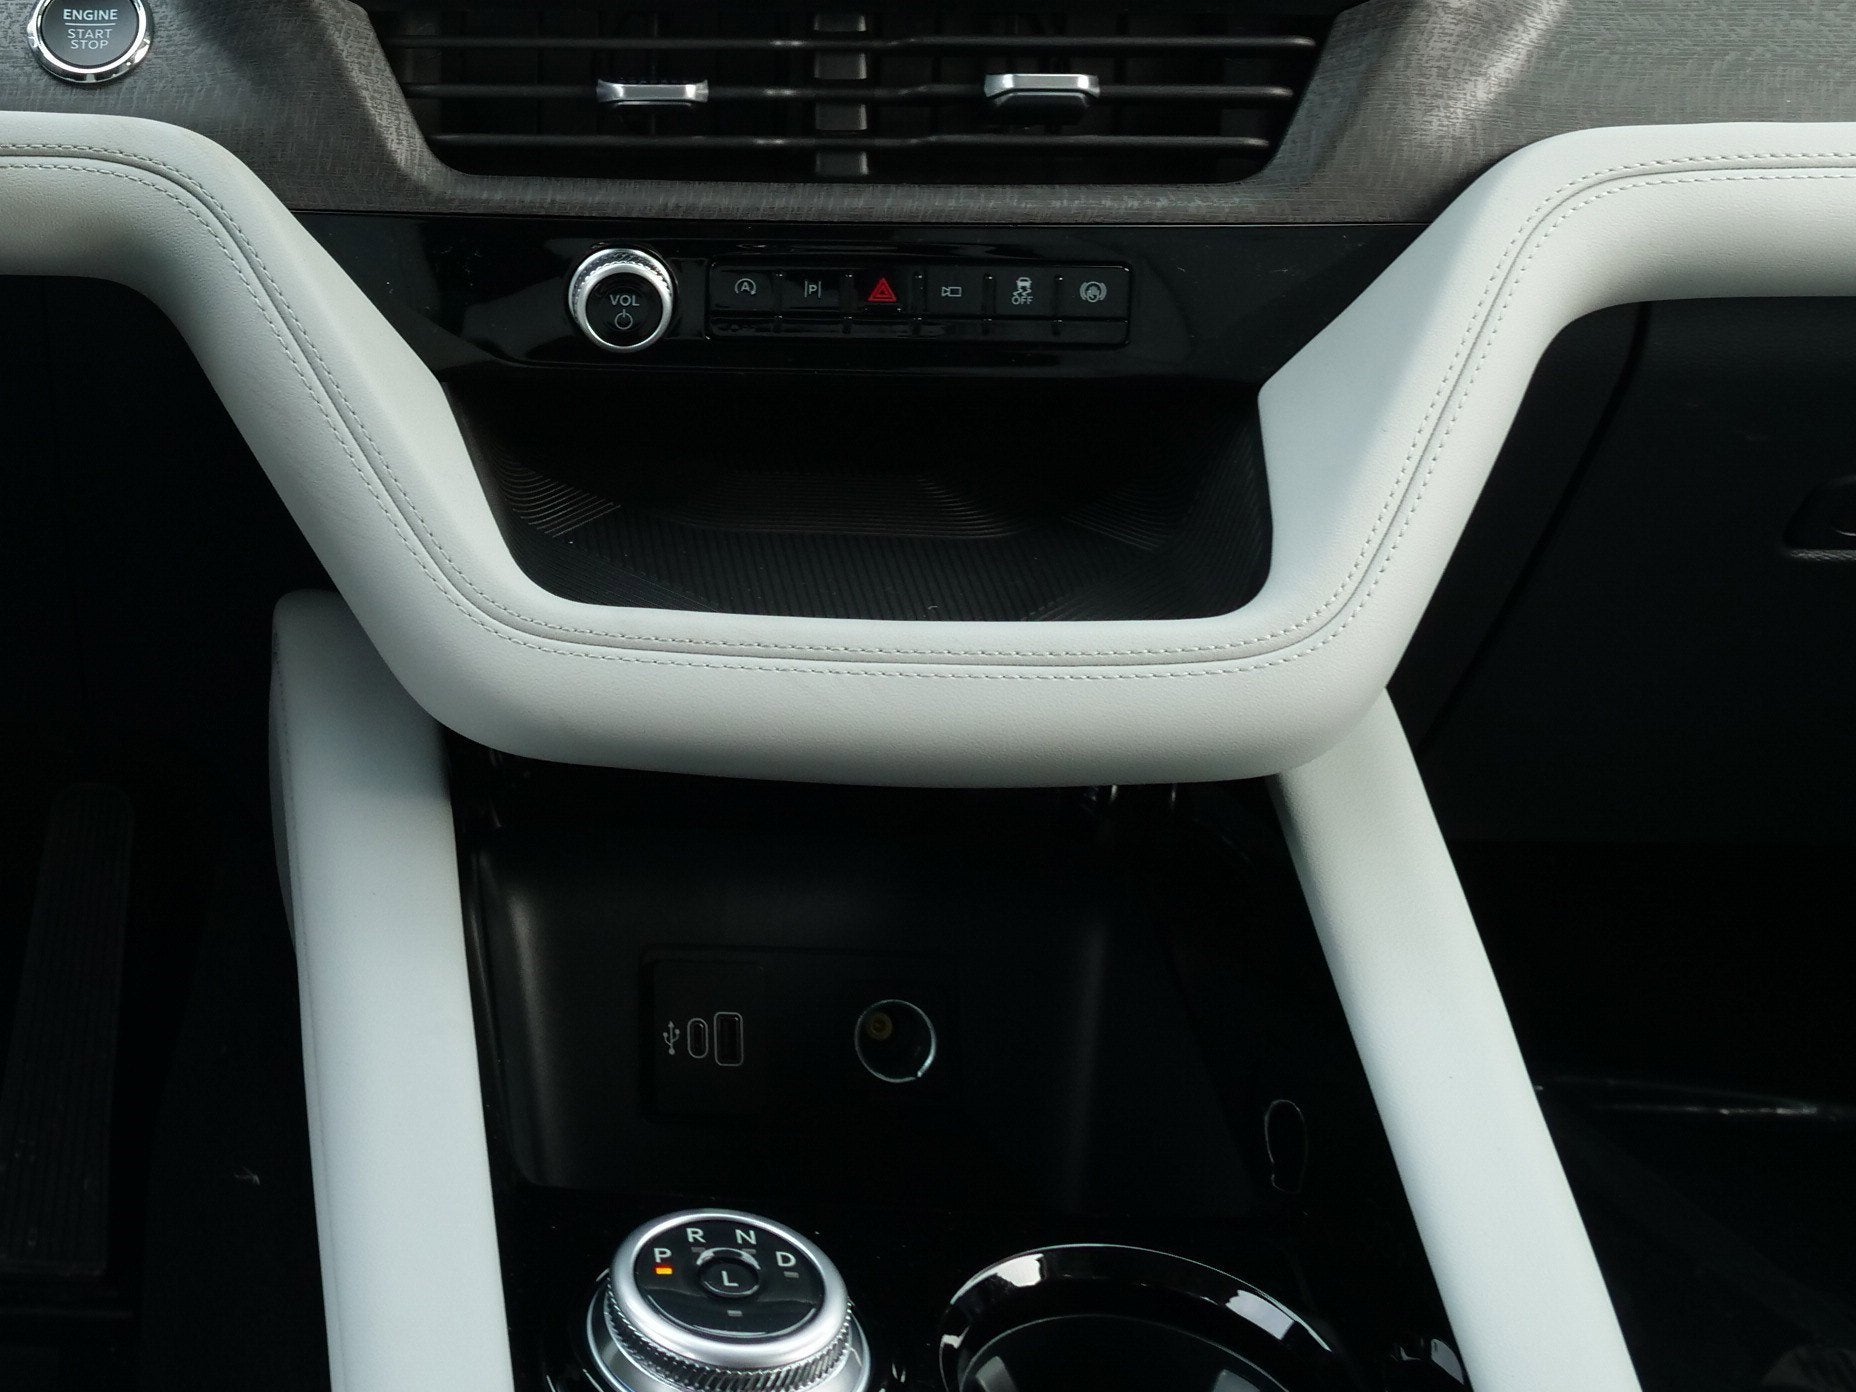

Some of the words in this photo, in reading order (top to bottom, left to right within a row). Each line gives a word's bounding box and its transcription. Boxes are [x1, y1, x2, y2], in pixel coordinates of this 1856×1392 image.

[62, 8, 118, 21] ENGINE
[67, 28, 113, 39] START
[70, 39, 109, 50] STOP
[609, 294, 640, 307] VOL
[1011, 295, 1033, 306] OFF
[653, 1247, 672, 1263] P
[686, 1227, 706, 1243] R
[735, 1229, 757, 1245] N
[775, 1251, 797, 1268] D
[721, 1270, 739, 1287] L
